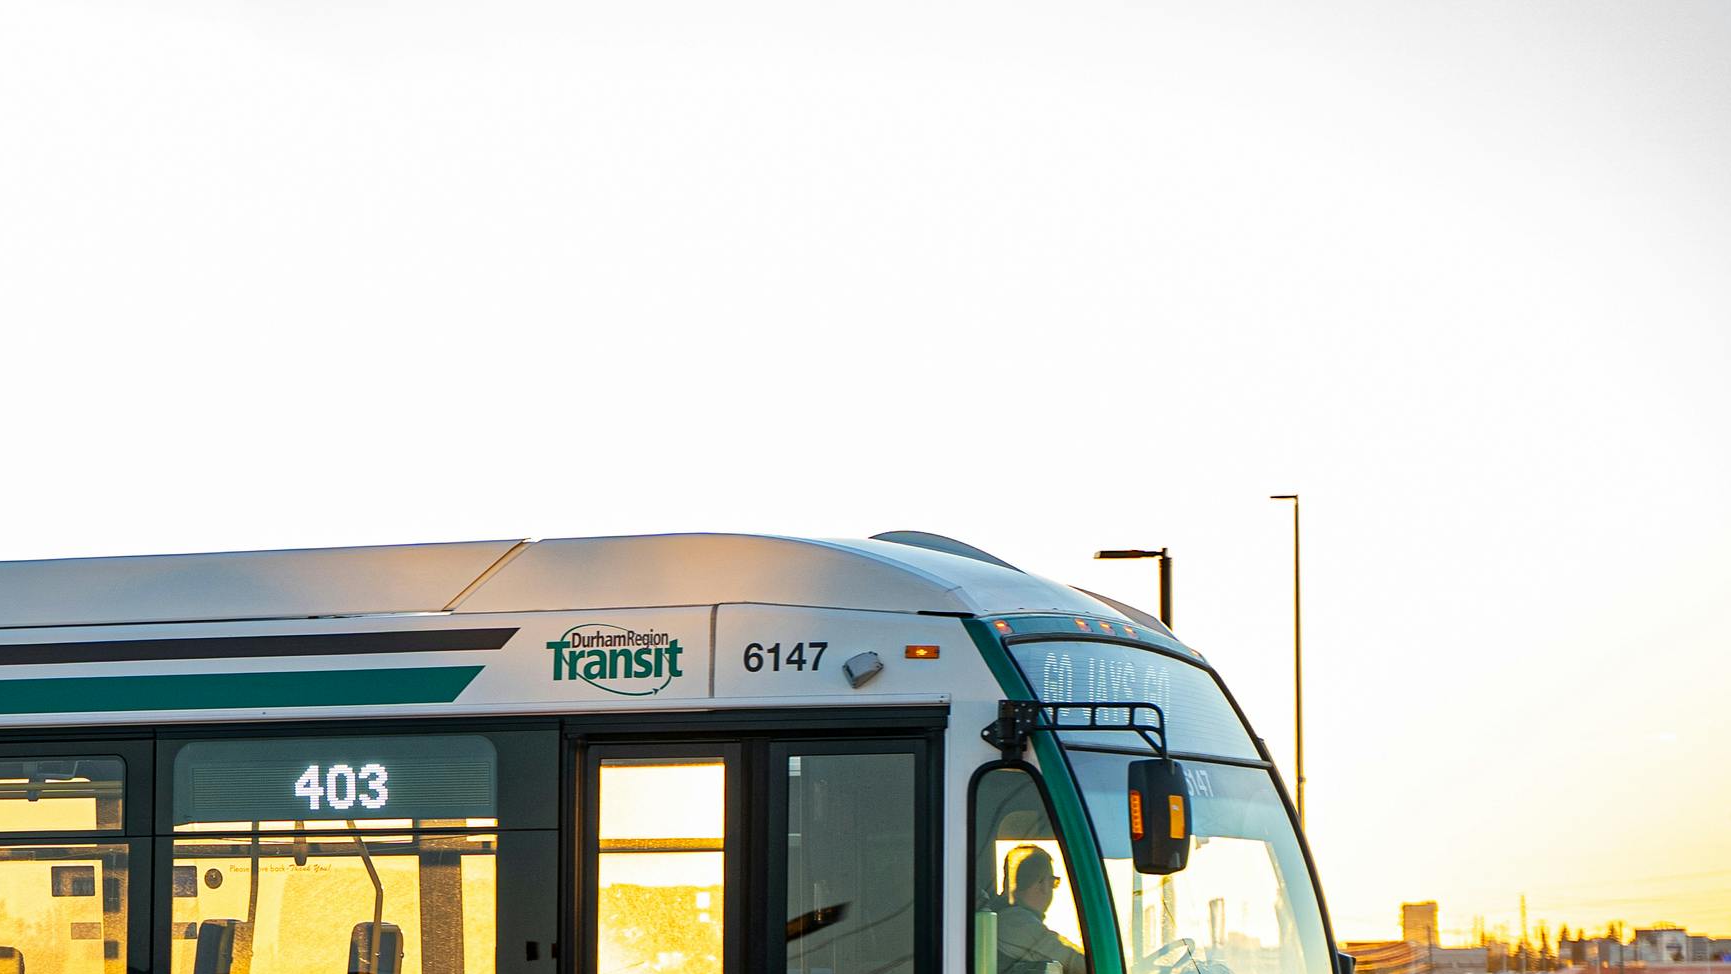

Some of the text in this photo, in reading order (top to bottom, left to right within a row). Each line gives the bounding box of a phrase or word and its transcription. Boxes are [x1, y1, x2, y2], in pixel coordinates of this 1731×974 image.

[546, 638, 683, 681] Transit
[743, 641, 828, 672] 6147
[294, 764, 389, 810] 403
